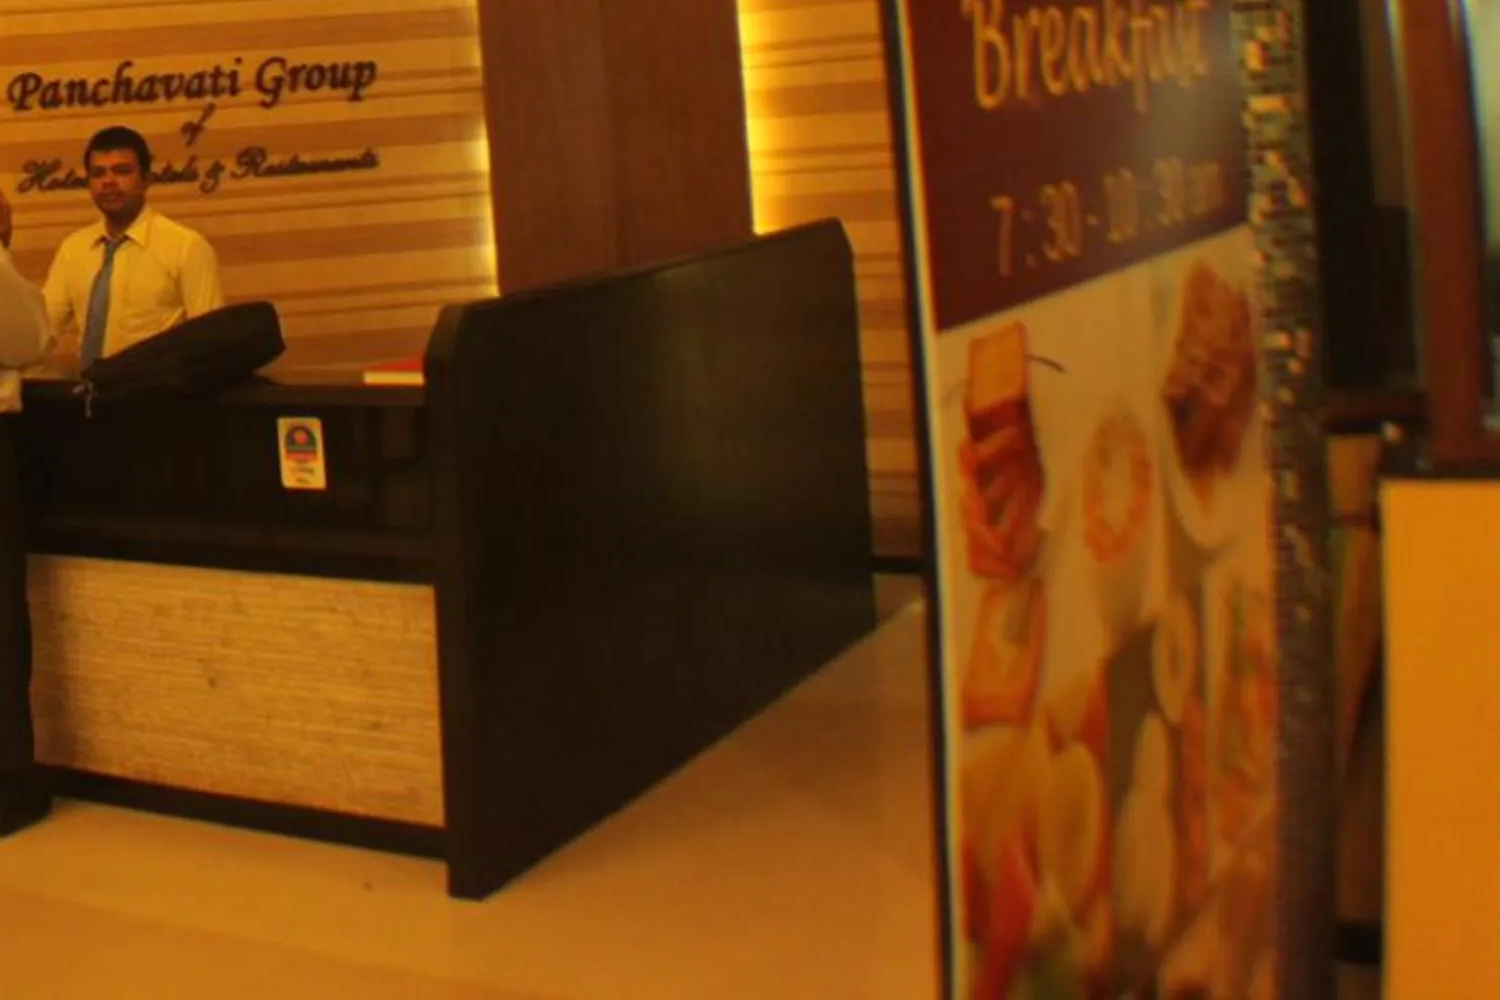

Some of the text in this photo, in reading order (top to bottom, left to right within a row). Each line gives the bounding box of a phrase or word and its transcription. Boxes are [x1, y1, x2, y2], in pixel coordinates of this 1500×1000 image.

[7, 56, 377, 111] Panchavati Group
[180, 102, 217, 146] of
